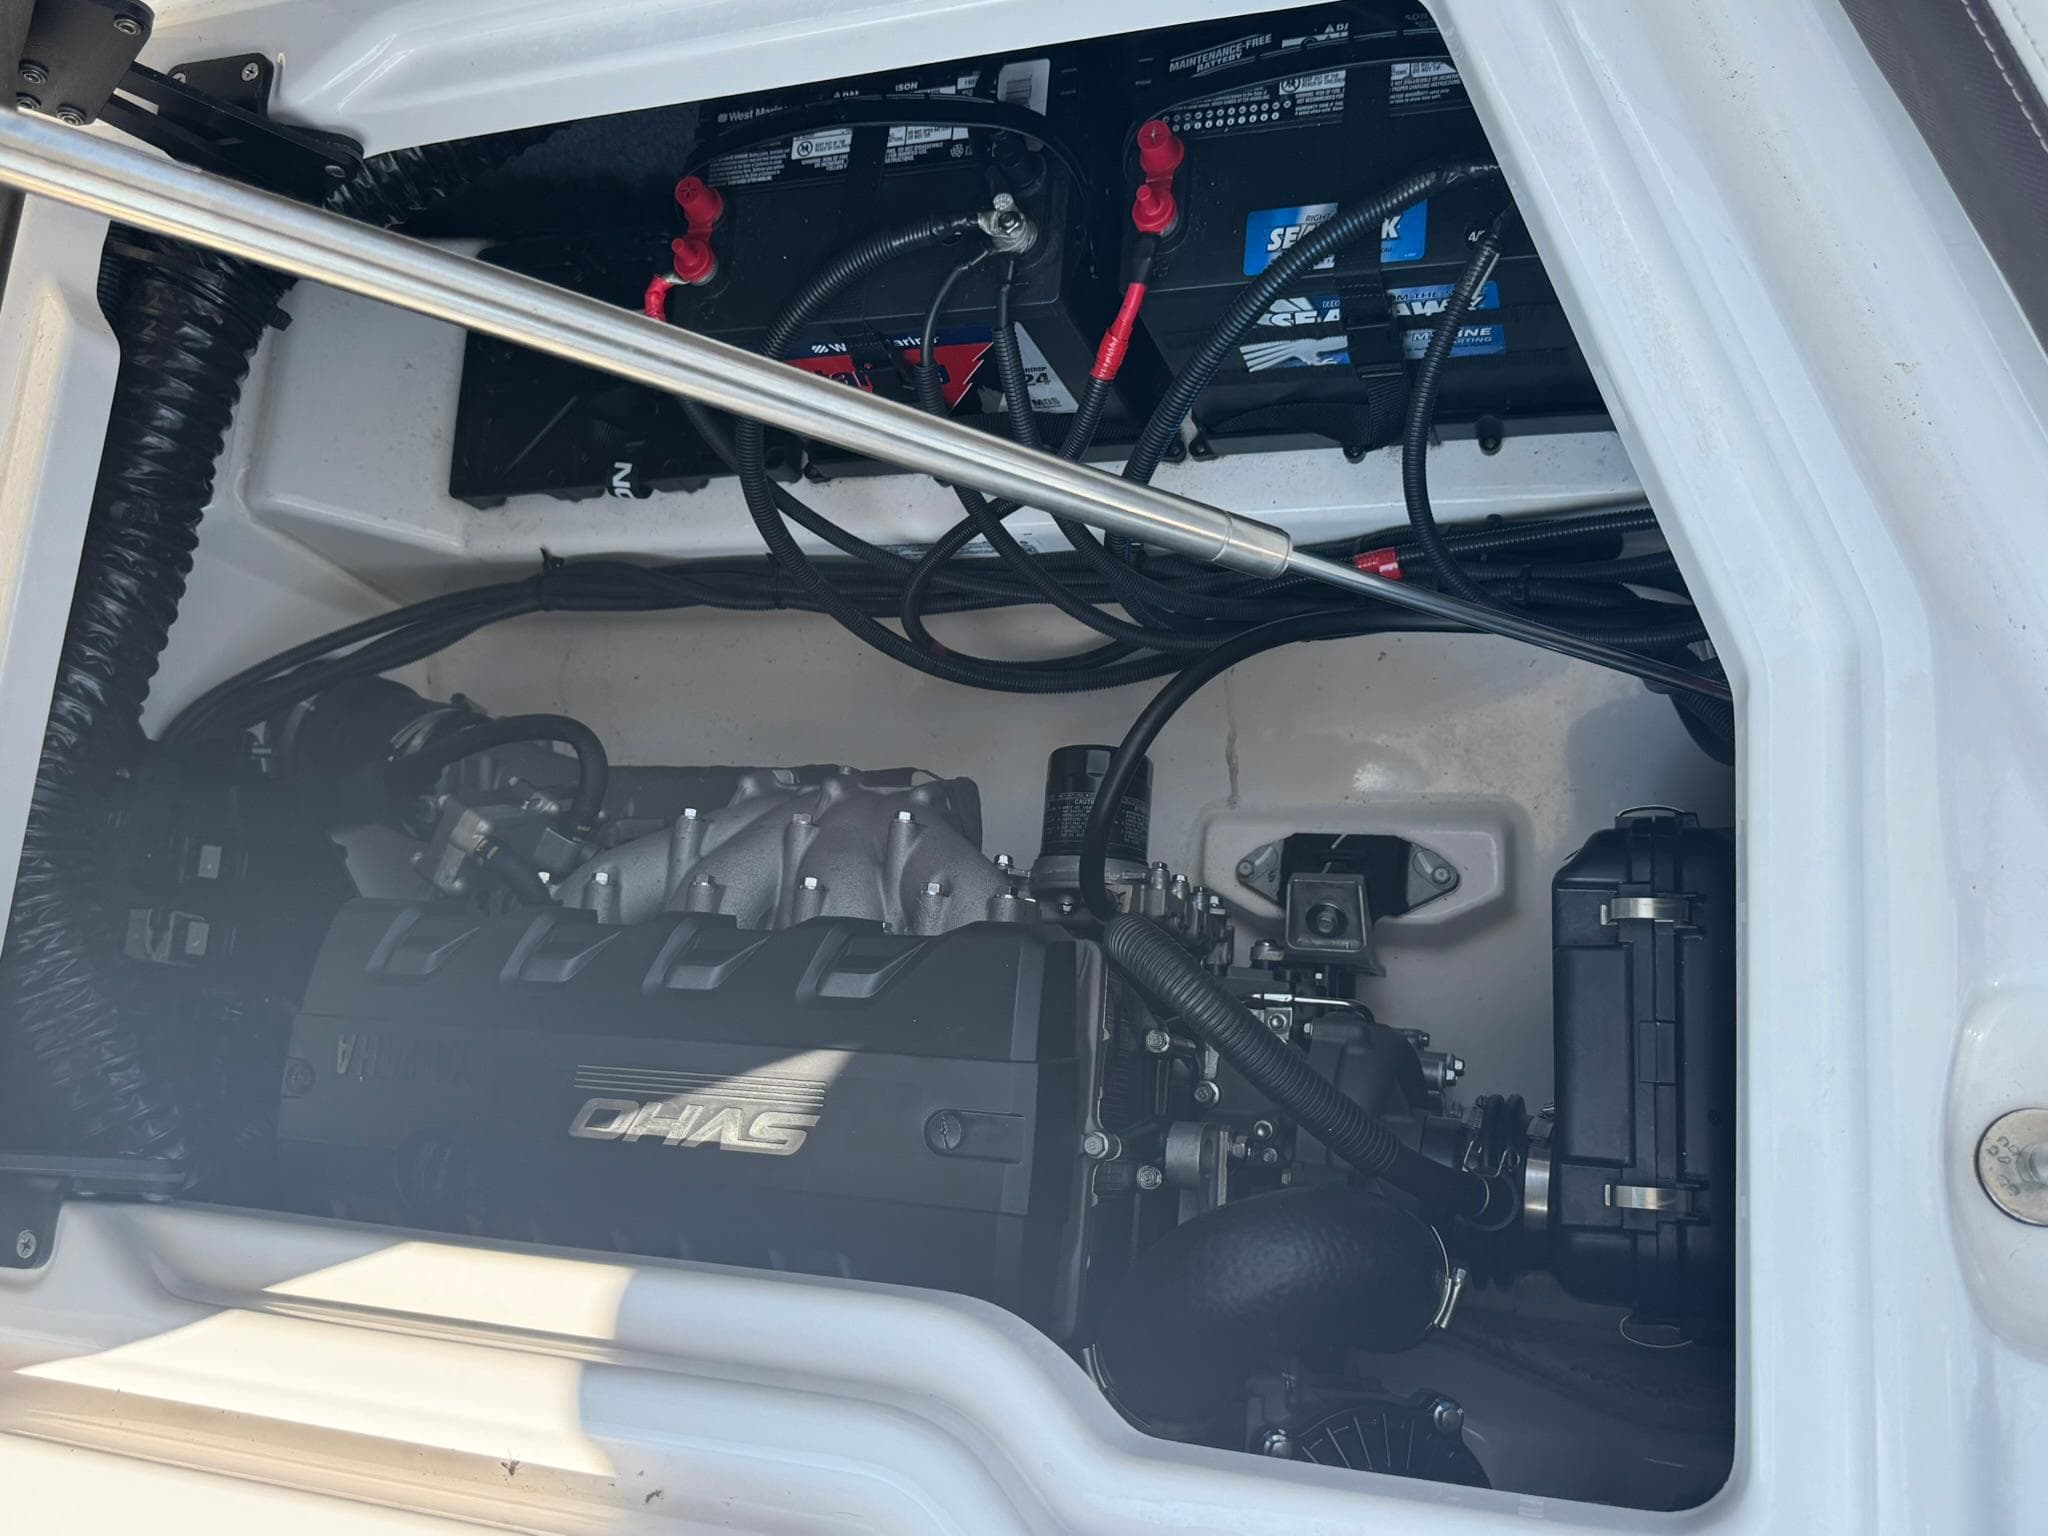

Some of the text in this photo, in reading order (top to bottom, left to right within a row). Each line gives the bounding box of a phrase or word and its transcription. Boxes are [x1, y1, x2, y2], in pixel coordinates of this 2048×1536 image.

[1169, 33, 1273, 73] MAINTENANCE-FREE
[1196, 52, 1243, 72] BATTERY
[728, 109, 754, 122] West
[1305, 213, 1333, 223] RIGHT
